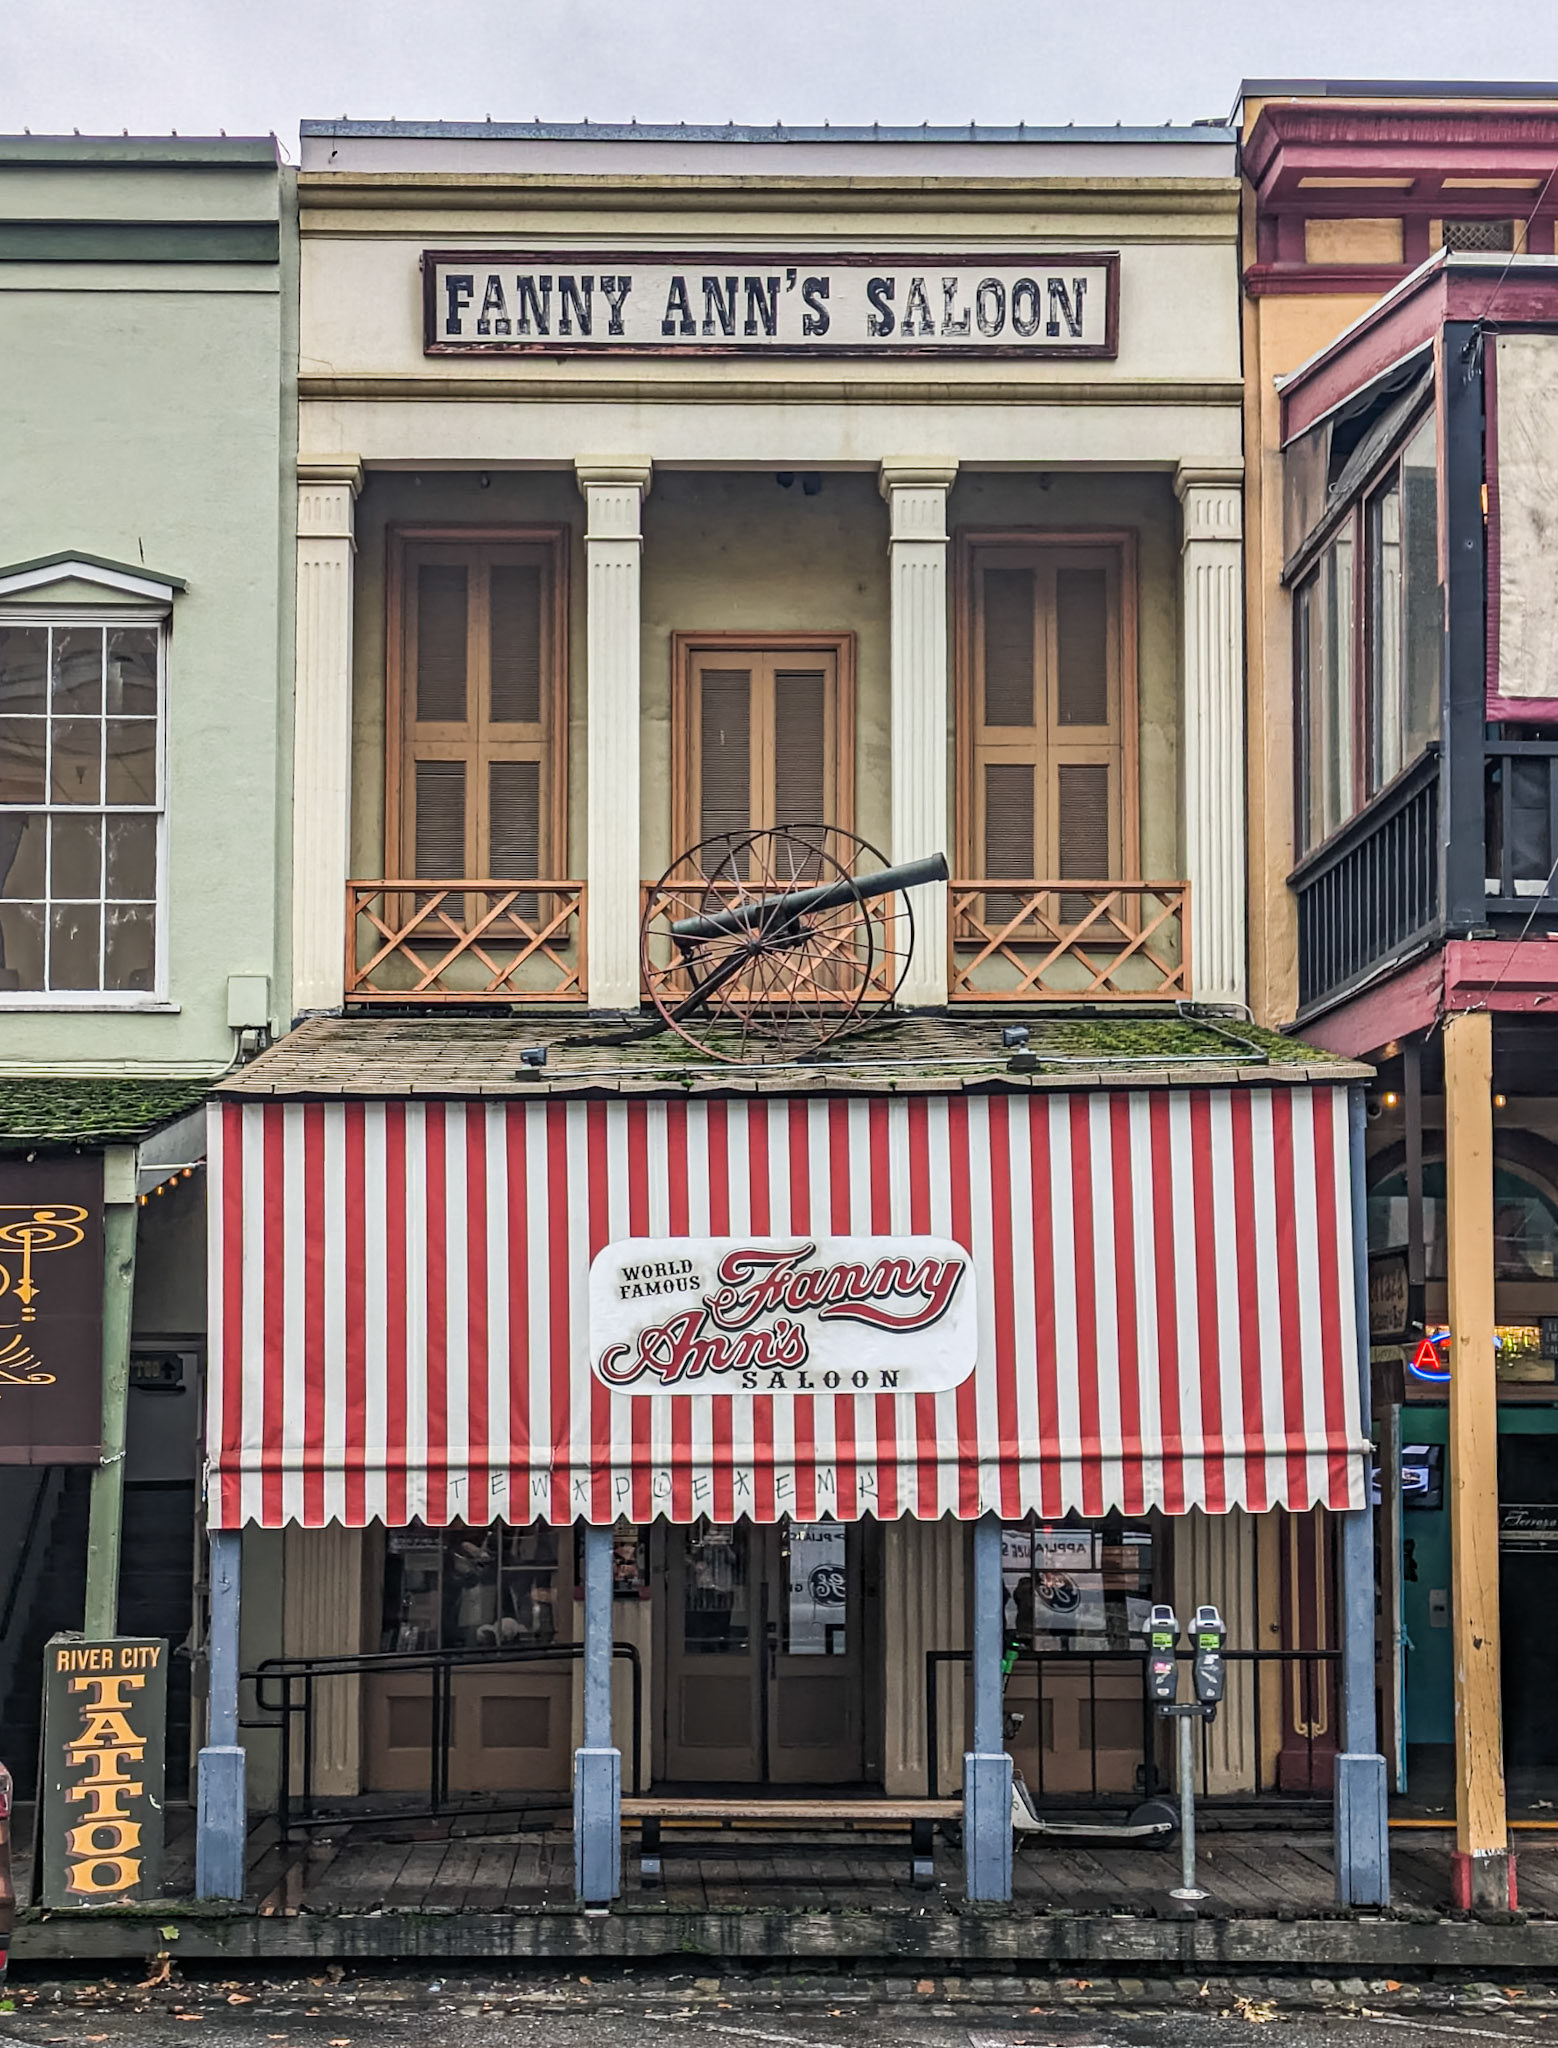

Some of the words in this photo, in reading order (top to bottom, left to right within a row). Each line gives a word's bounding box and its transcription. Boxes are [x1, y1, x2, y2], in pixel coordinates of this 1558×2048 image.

[445, 275, 632, 336] FANNY
[663, 269, 830, 336] ANN'S
[867, 277, 1088, 338] SALOON
[620, 1275, 700, 1299] FAMOUS
[622, 1259, 693, 1281] WORLD
[704, 1243, 965, 1334] Fanny
[600, 1308, 809, 1385] Ann's
[742, 1370, 899, 1389] SALOON
[57, 1648, 113, 1671] RIVER
[121, 1646, 161, 1669] CITY
[63, 1673, 147, 1894] TATTOO
